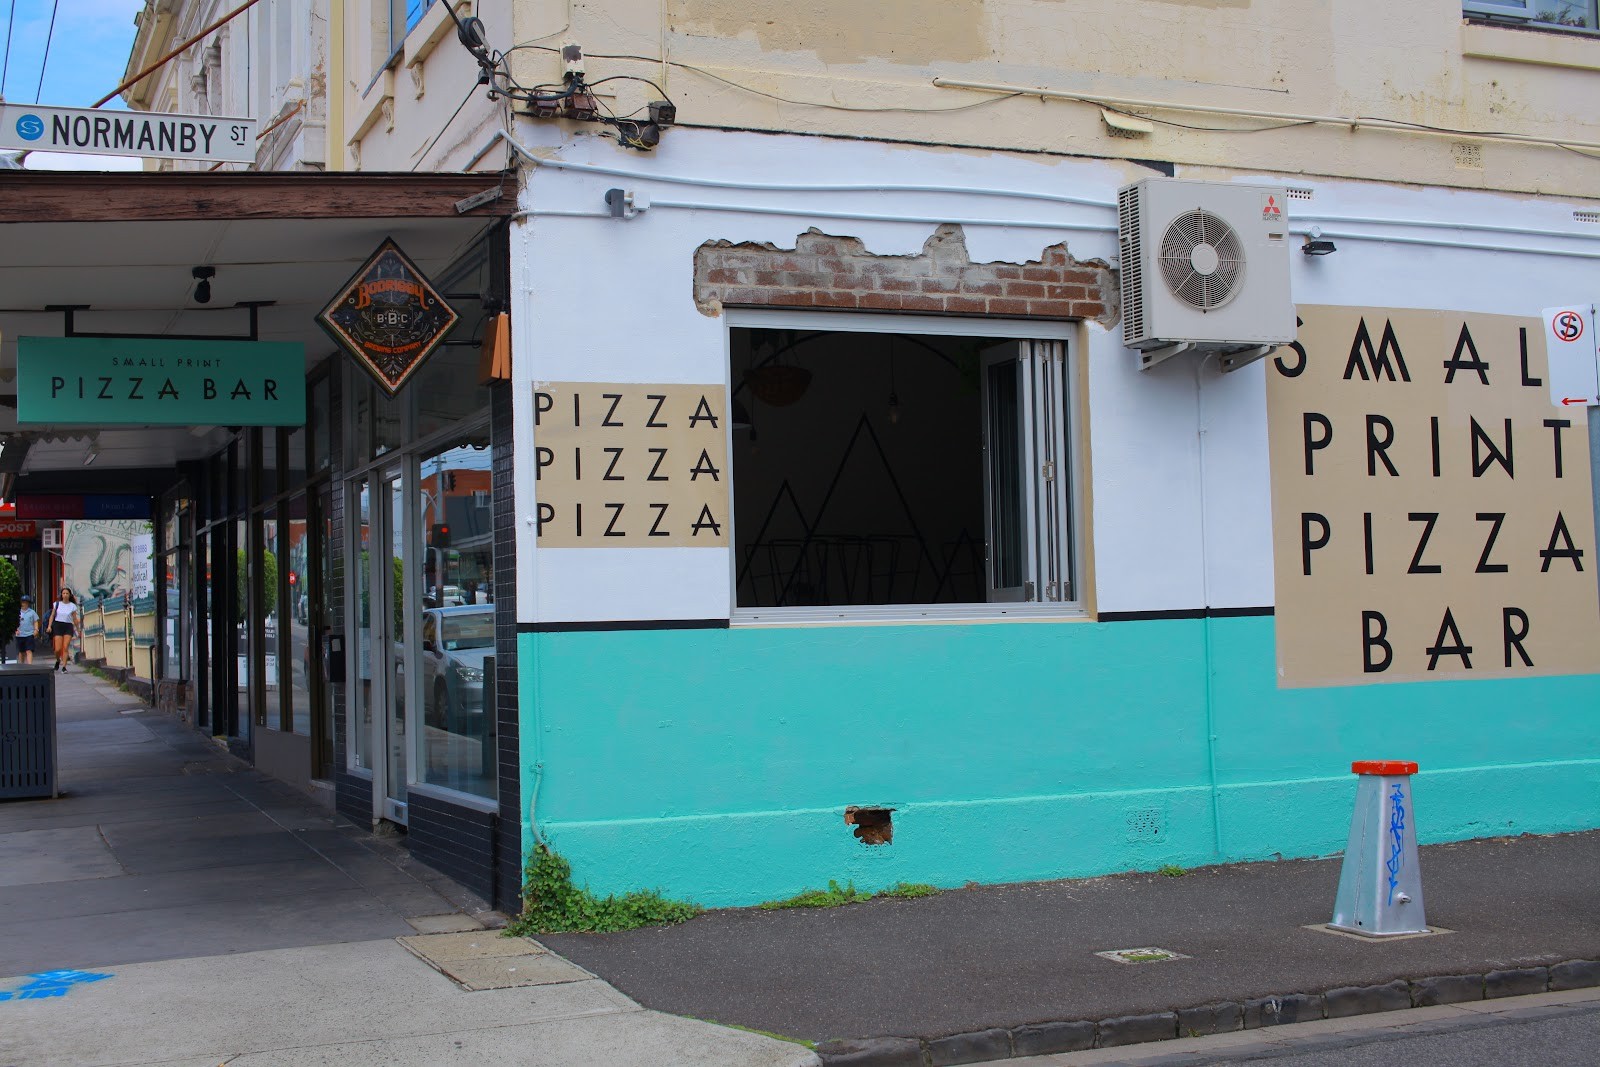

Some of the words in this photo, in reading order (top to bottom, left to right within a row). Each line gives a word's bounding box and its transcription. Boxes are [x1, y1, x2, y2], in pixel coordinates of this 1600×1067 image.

[52, 114, 217, 154] NORMANBY
[230, 125, 249, 146] ST
[112, 357, 165, 368] SMALL
[177, 358, 221, 368] PRINT
[1273, 315, 1542, 387] SMAL
[51, 376, 179, 400] PIZZA
[203, 377, 279, 401] BAR
[534, 392, 718, 429] PIZZA
[535, 446, 720, 481] PIZZA
[1302, 412, 1571, 481] PRINT
[0, 523, 32, 533] POST
[536, 502, 721, 537] PIZZA
[1301, 510, 1584, 575] PIZZA
[132, 570, 148, 582] edical
[1361, 605, 1535, 673] BAR
